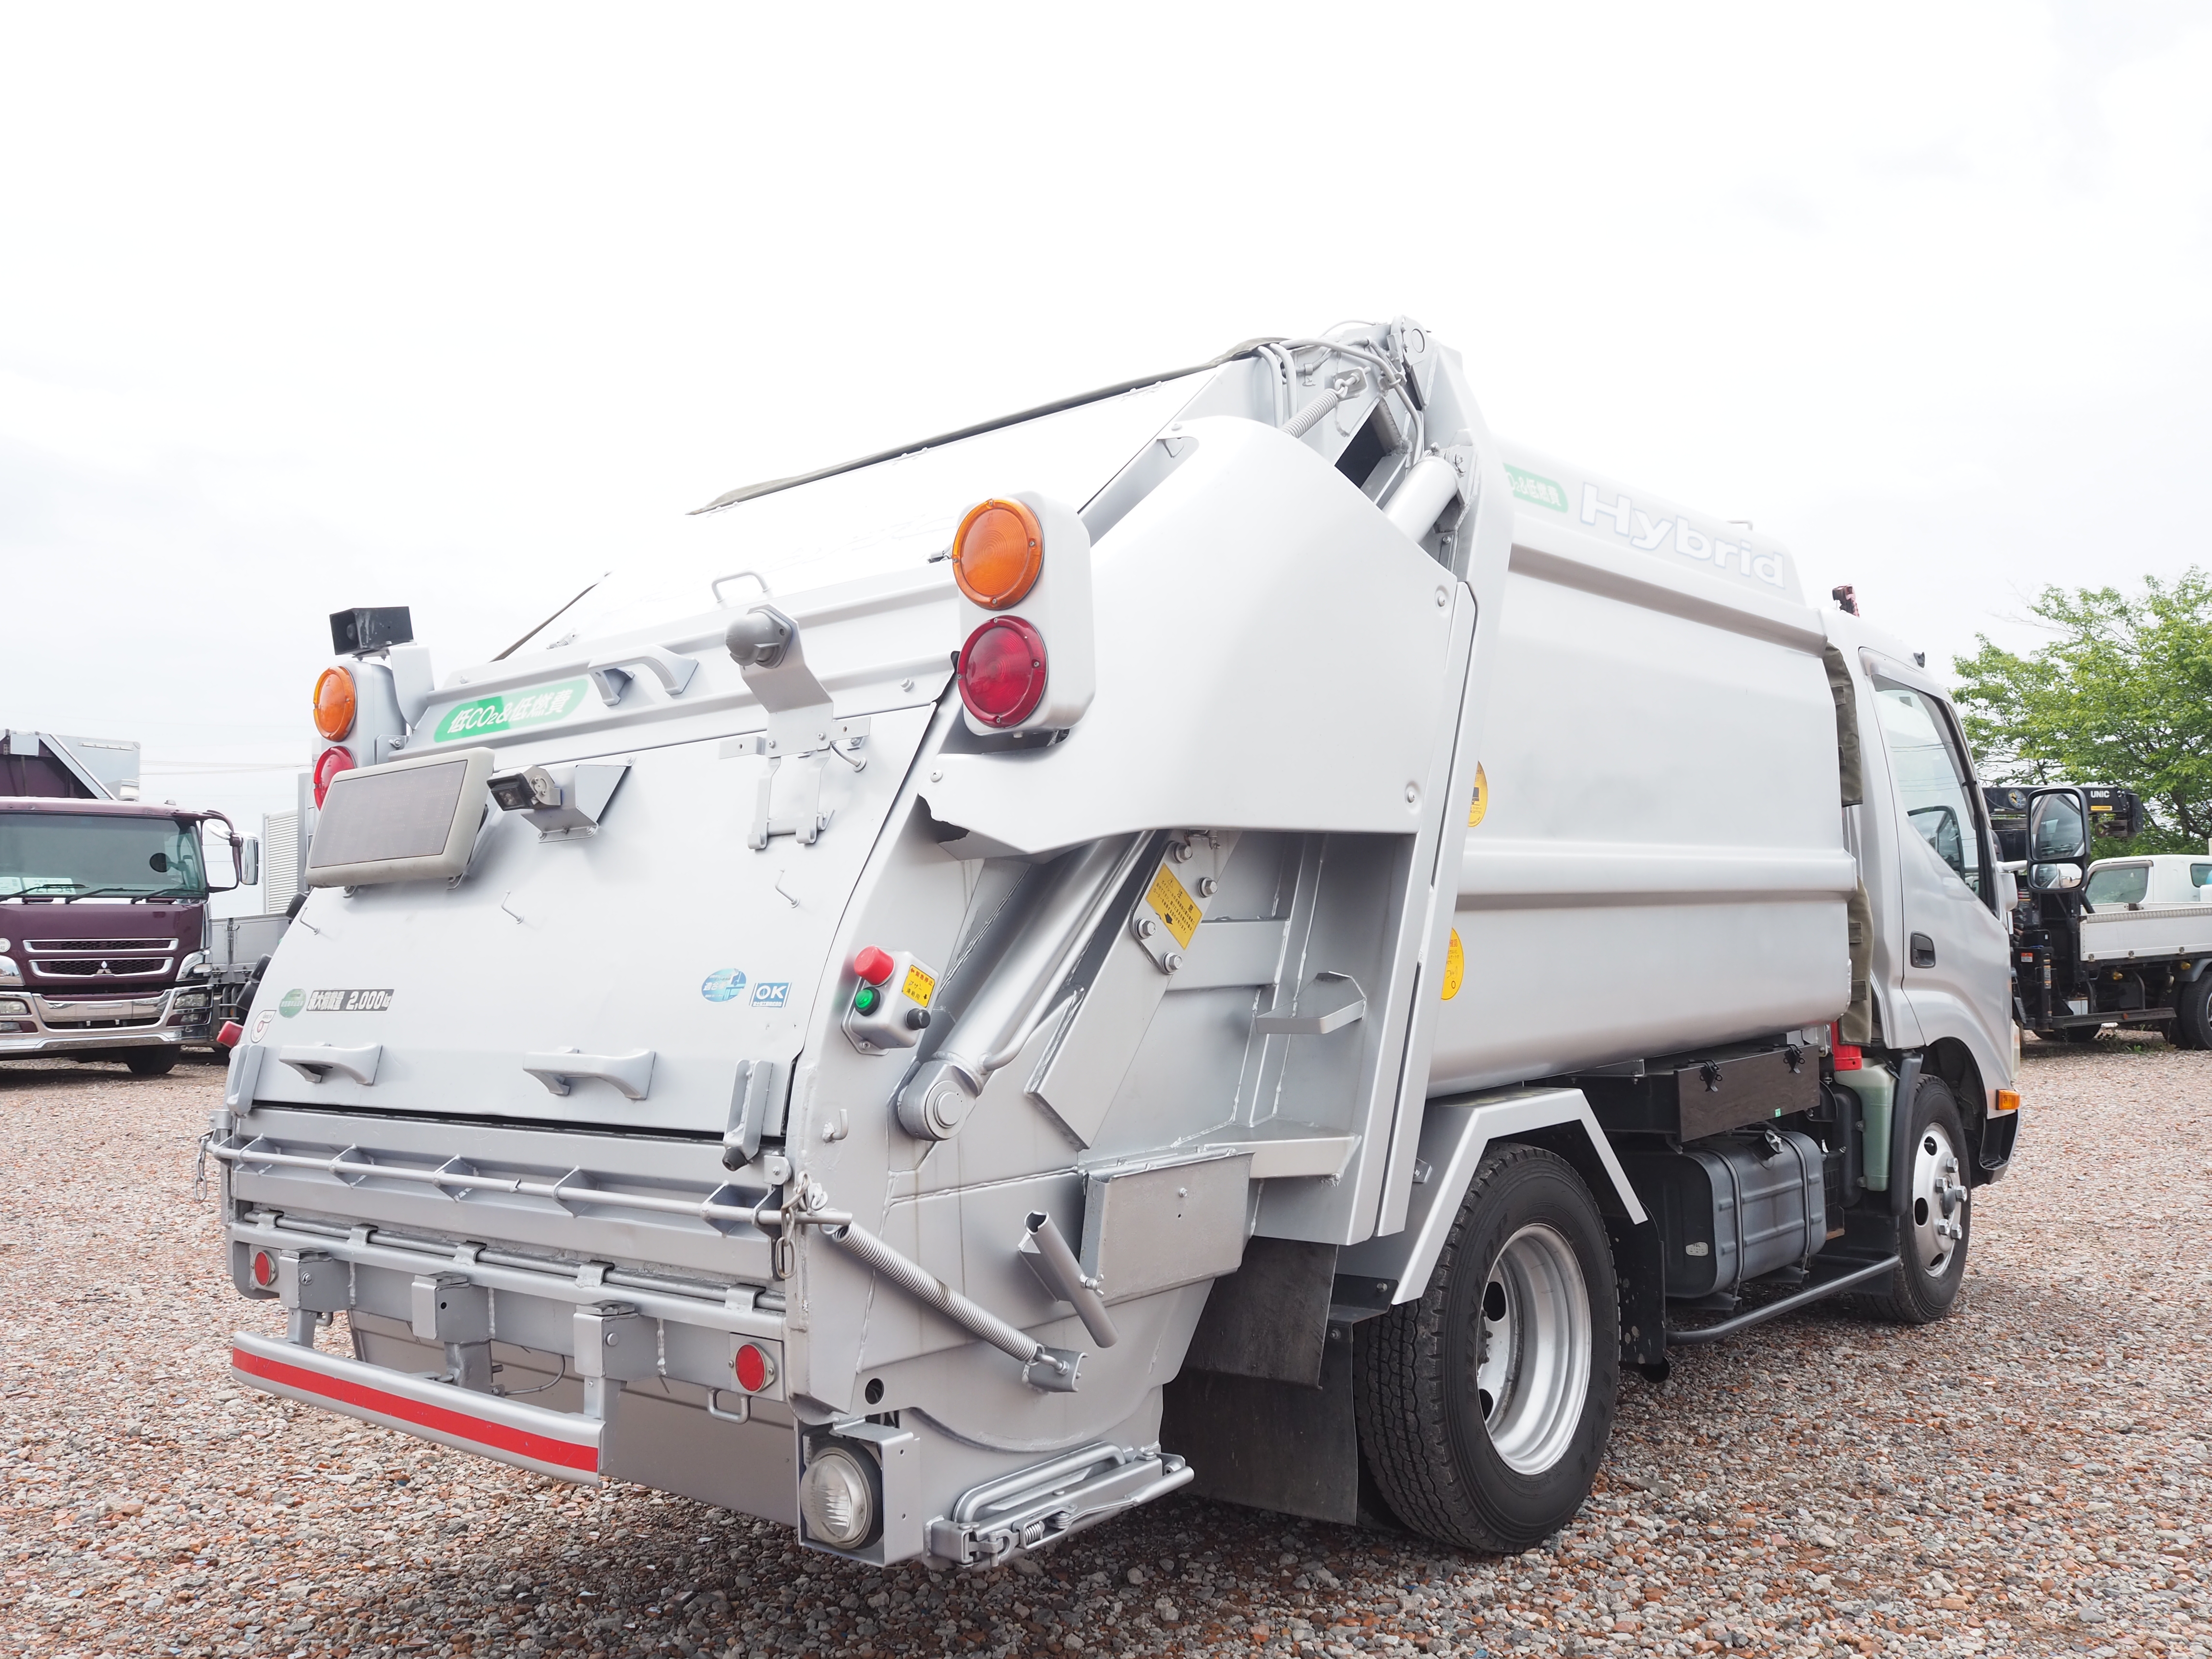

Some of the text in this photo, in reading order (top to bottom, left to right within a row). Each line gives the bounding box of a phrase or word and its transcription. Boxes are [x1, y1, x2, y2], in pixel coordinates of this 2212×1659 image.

[1580, 481, 1786, 589] Hybrid
[2090, 790, 2110, 798] UNIC
[915, 971, 933, 986] 緊急停止
[756, 985, 787, 1000] OK
[308, 991, 344, 1010] 最大積載量
